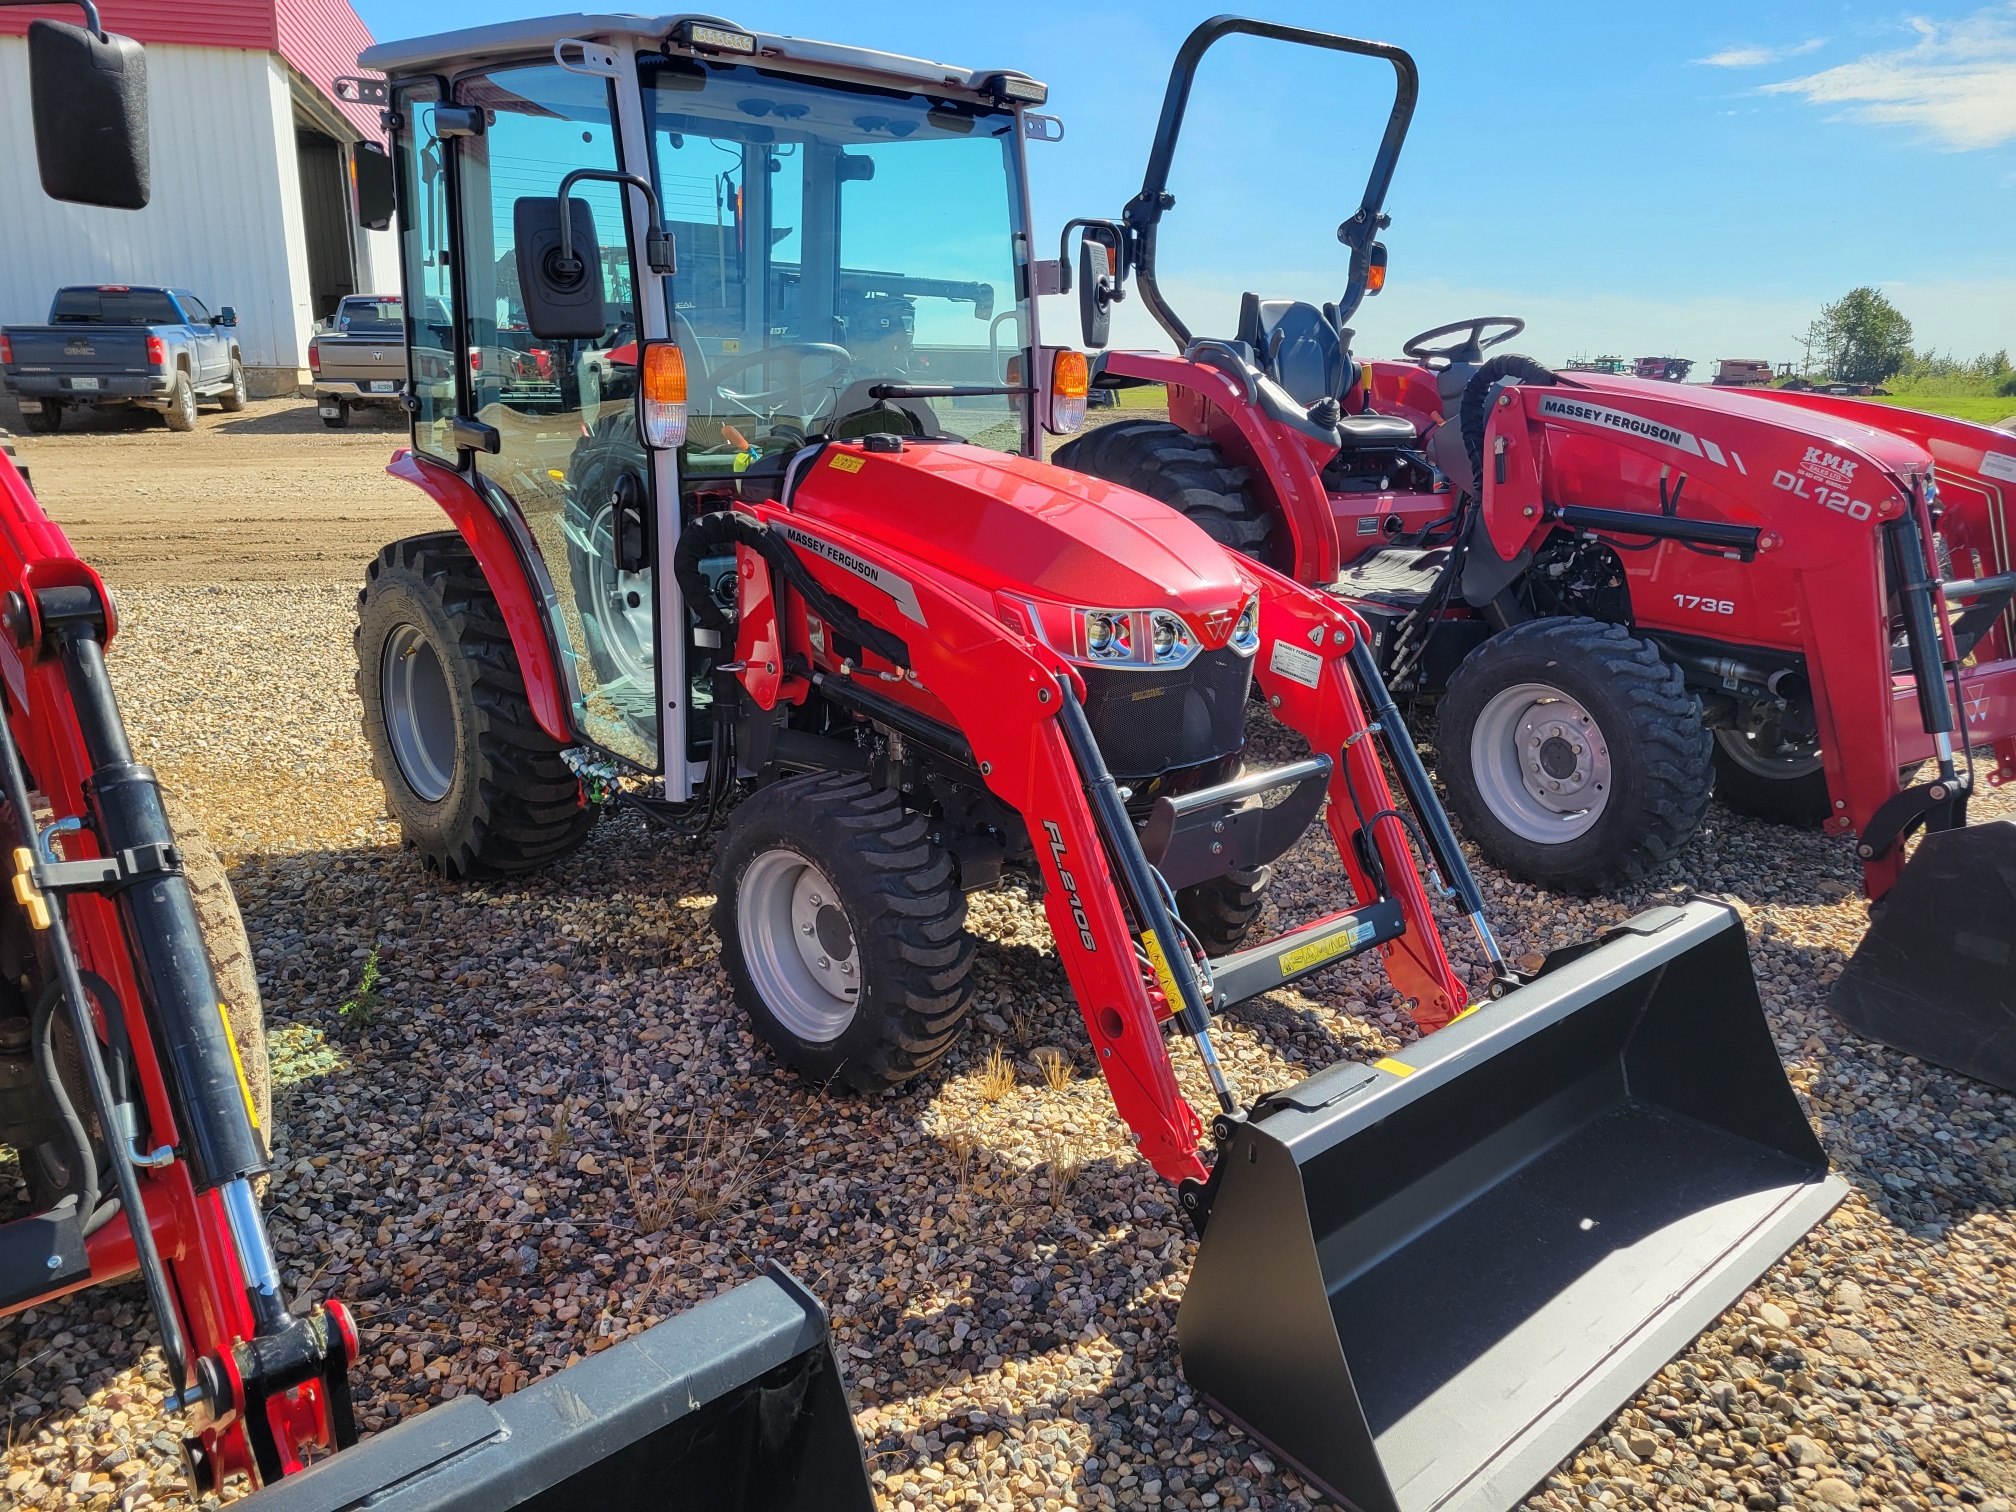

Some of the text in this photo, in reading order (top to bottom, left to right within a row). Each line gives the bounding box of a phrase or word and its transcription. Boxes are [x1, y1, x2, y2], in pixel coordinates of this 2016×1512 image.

[63, 347, 96, 356] GMC
[1544, 400, 1682, 445] MASSEY FERGUSON
[1809, 465, 1829, 477] SALES
[787, 528, 879, 582] MASSEY FERGUSON
[1673, 593, 1735, 615] 1736
[1278, 642, 1296, 653] MASSEY
[1295, 649, 1319, 661] FERGUSON
